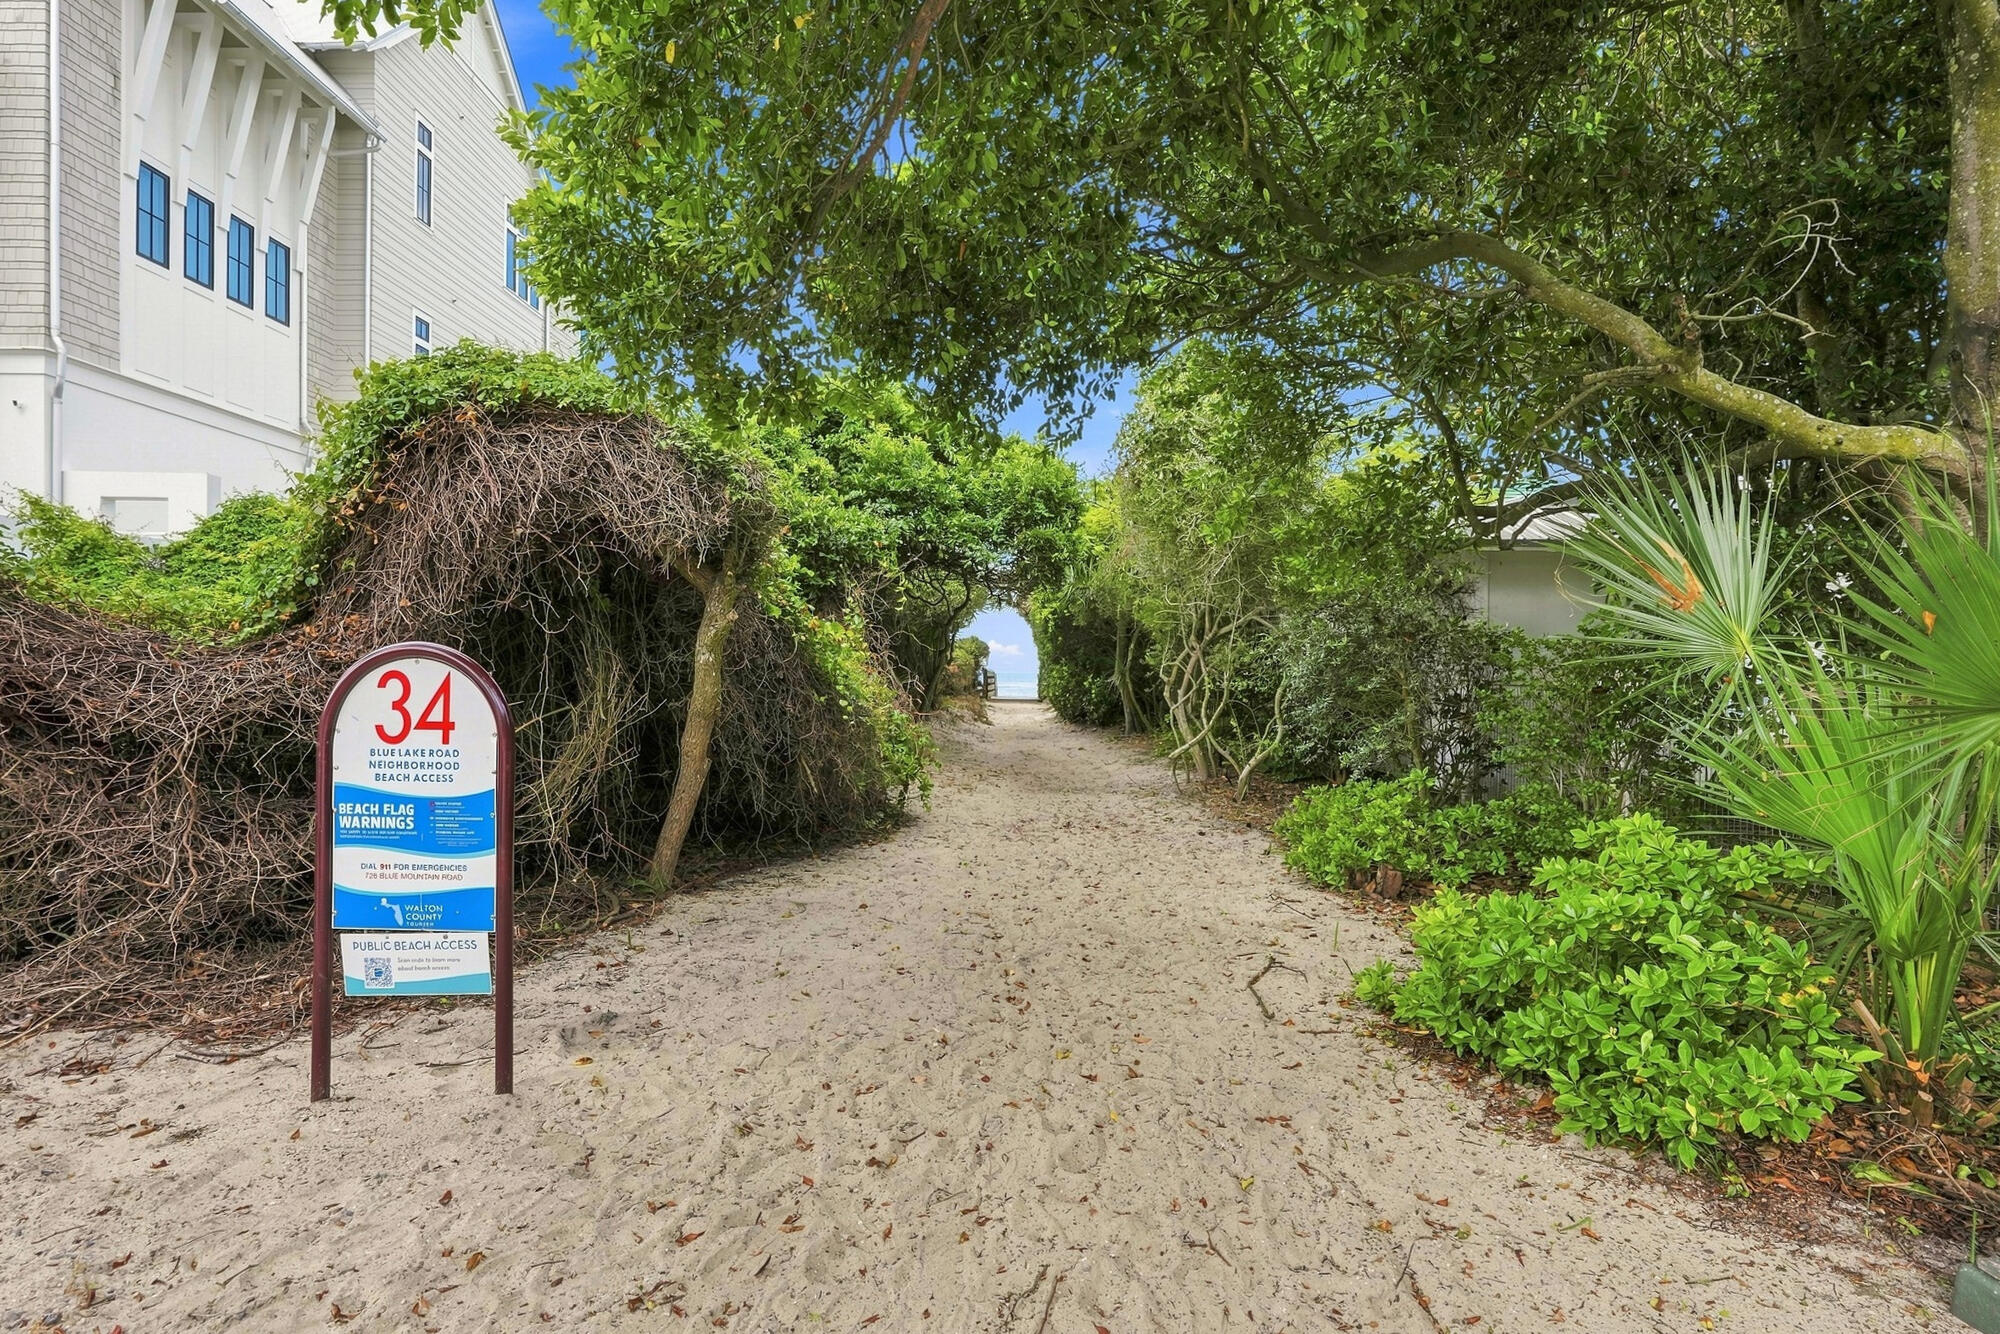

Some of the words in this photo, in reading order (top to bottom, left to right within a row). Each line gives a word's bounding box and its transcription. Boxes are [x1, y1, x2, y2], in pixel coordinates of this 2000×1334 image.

[375, 669, 456, 745] 34
[369, 748, 396, 757] BLUE
[398, 748, 426, 758] LAKE
[428, 748, 460, 758] ROAD
[368, 760, 460, 771] NEIGHBORHOOD
[374, 773, 411, 782] BEACH
[413, 773, 454, 783] ACCESS
[338, 803, 379, 815] BEACH
[383, 804, 415, 816] FLAG
[339, 816, 415, 830] WARNINGS
[393, 863, 410, 871] FOR
[411, 864, 468, 872] EMERGENCIES
[379, 872, 399, 880] BLUE
[400, 873, 440, 881] MOUNTAIN
[404, 904, 443, 912] WALTON
[405, 912, 442, 921] COUNTY
[353, 941, 392, 951] PUBLIC
[394, 940, 431, 951] BEACH
[434, 940, 478, 950] ACCESS
